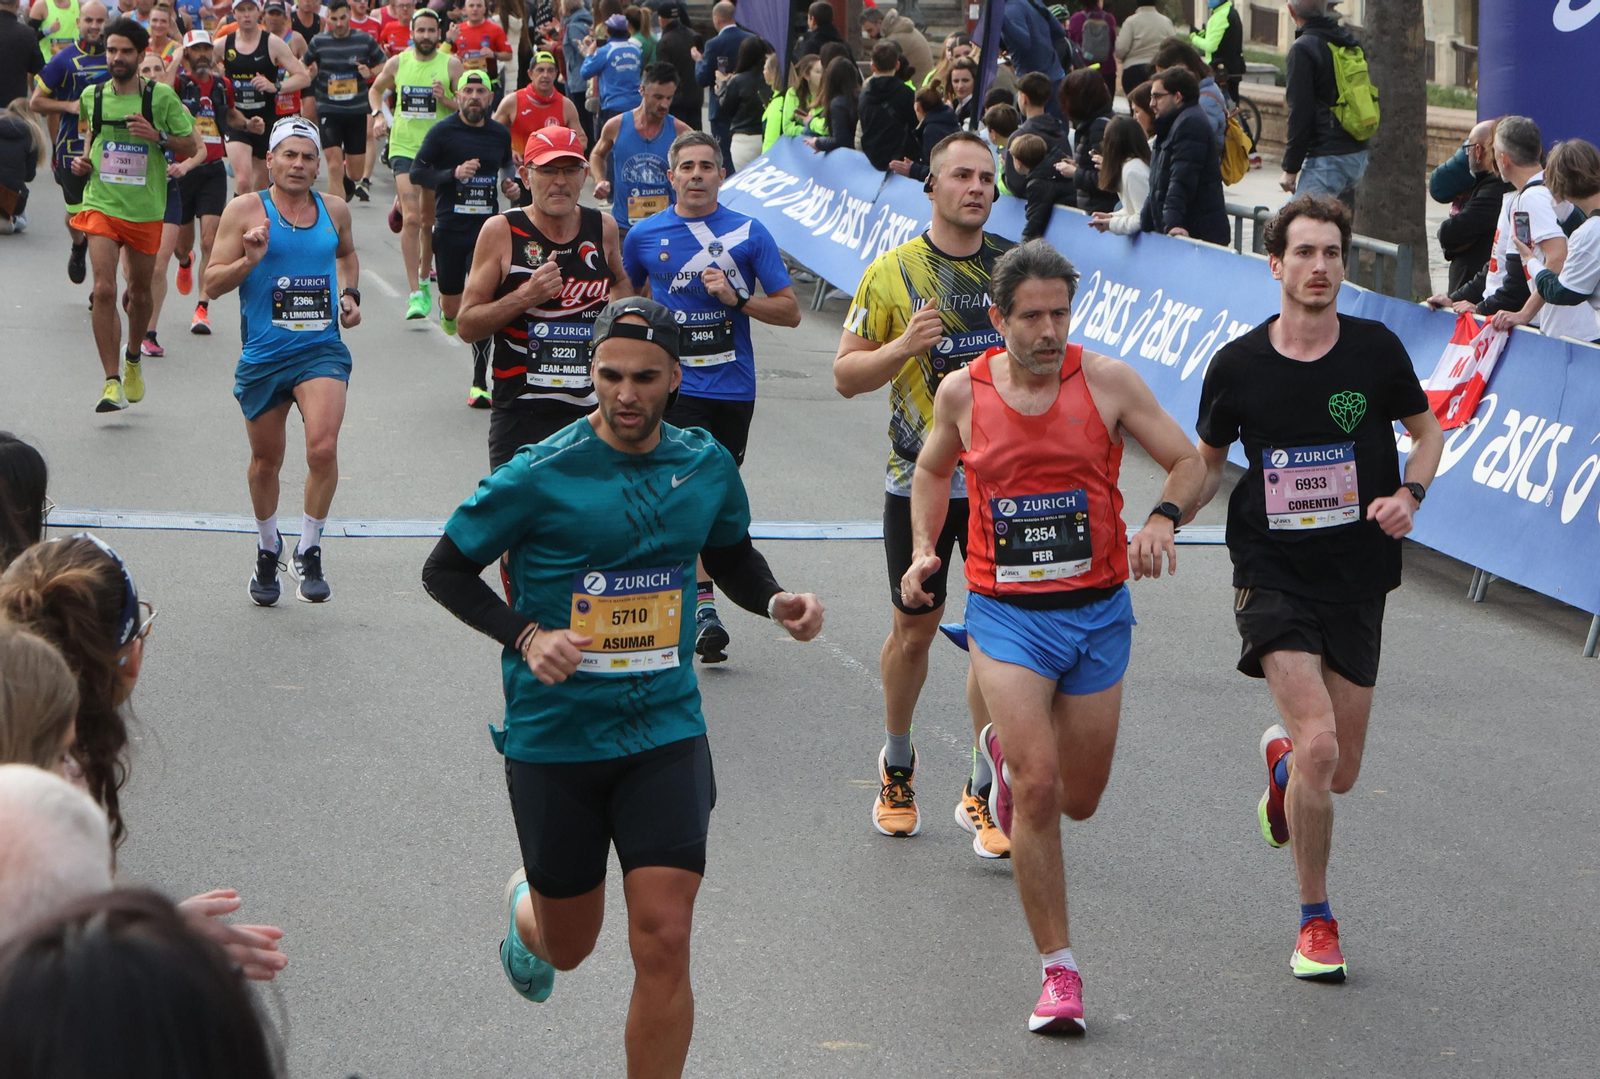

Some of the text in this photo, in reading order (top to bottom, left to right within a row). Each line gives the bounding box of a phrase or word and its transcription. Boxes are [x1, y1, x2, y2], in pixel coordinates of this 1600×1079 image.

[118, 144, 143, 152] ZURICH
[735, 165, 800, 199] asics
[782, 184, 835, 228] asics
[830, 196, 872, 250] asics
[677, 269, 736, 280] DEPOVO
[294, 278, 325, 287] ZURICH
[293, 296, 314, 305] 2366
[691, 310, 726, 321] ZURICH
[1084, 280, 1140, 346] asics
[553, 326, 590, 336] ZURICH
[691, 330, 714, 341] 3494
[1140, 298, 1203, 366] asics
[959, 333, 1003, 348] ZURICH
[552, 348, 576, 358] 3220
[538, 364, 587, 374] JEAN-MARIE
[1294, 448, 1344, 463] ZURICH
[1472, 408, 1574, 504] asics
[1295, 477, 1327, 490] 6933
[1023, 496, 1076, 512] ZURICH
[1289, 497, 1338, 511] CORENTIN
[1024, 526, 1056, 542] 2354
[1032, 550, 1053, 562] FER
[614, 573, 670, 590] ZURICH
[612, 608, 647, 625] 5710
[603, 635, 654, 649] ASUMAR
